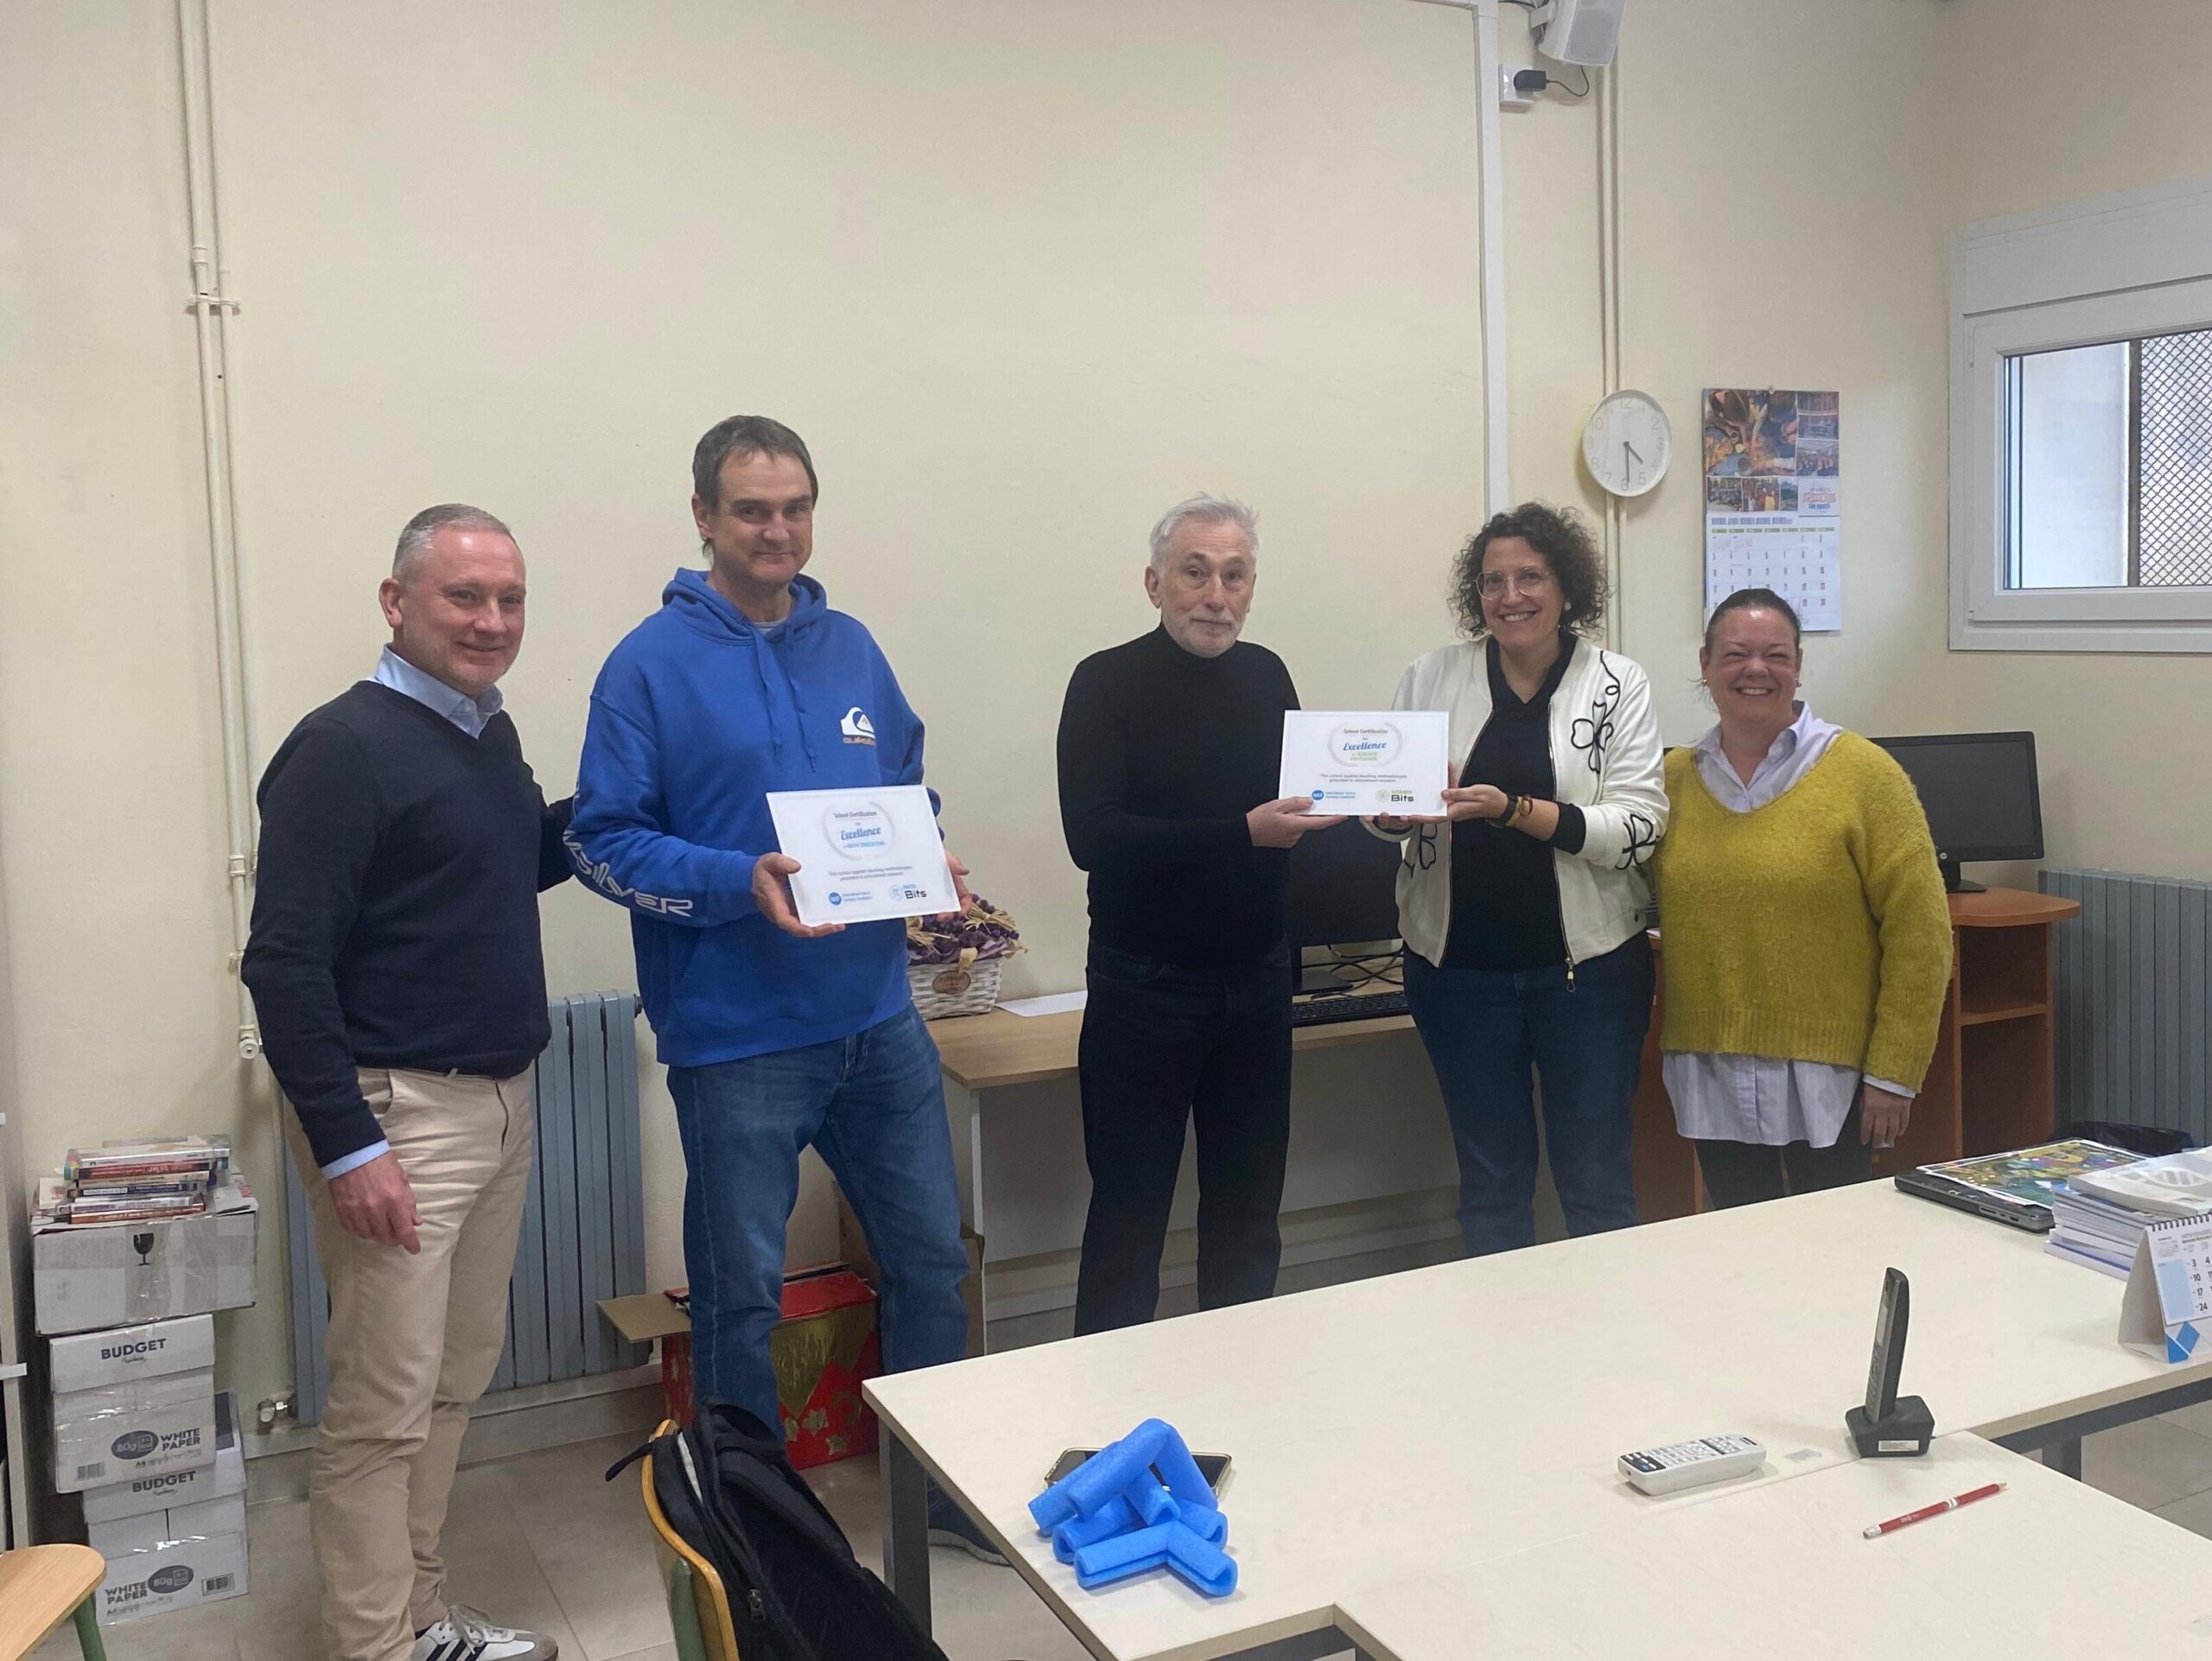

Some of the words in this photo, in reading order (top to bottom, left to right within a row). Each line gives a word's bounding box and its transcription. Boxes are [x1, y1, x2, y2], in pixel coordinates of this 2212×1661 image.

[1650, 416, 1660, 430] 2
[1656, 436, 1664, 451] 3
[1591, 456, 1600, 471] 8
[1604, 471, 1612, 482] 7
[1638, 471, 1647, 486] 5
[1343, 741, 1387, 751] Excellence
[841, 827, 881, 840] Excellence
[905, 889, 927, 900] Bits
[2191, 1258, 2197, 1268] 3
[2205, 1256, 2210, 1264] 4
[2193, 1273, 2201, 1282] 10
[2196, 1288, 2203, 1297] 17
[2198, 1302, 2208, 1312] 24
[101, 1338, 167, 1360] BUDGET
[161, 1428, 200, 1442] WHITE
[162, 1437, 201, 1452] PAPER
[132, 1470, 196, 1493] BUDGET
[105, 1581, 148, 1597] WHITE
[107, 1589, 148, 1605] PAPER
